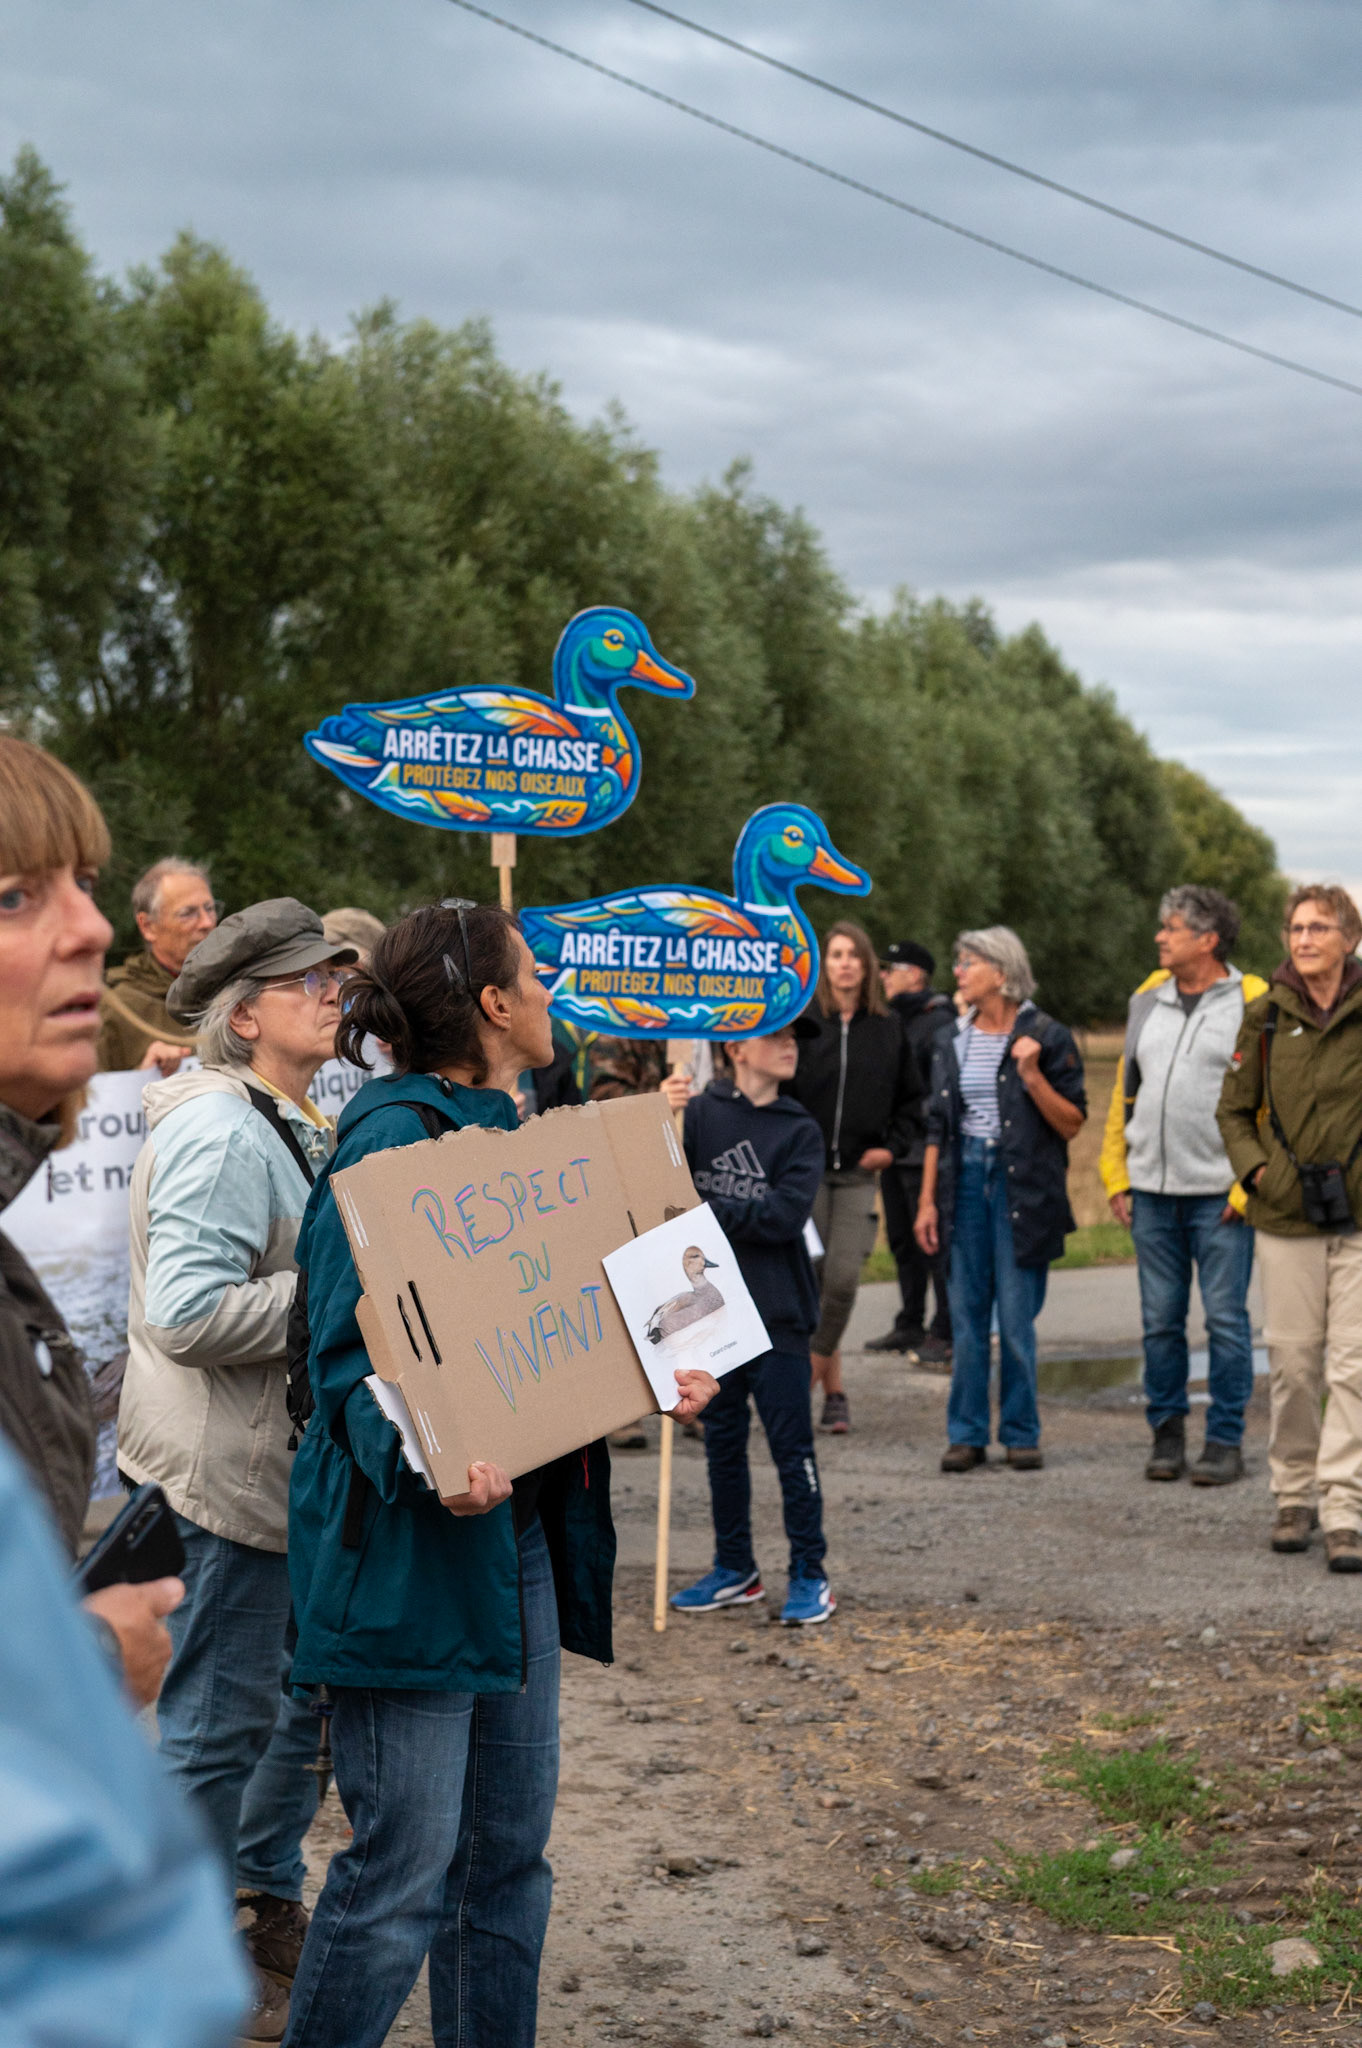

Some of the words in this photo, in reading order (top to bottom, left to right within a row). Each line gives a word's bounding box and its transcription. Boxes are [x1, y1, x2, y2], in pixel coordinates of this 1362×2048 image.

[383, 725, 483, 764] ARRÊTEZ
[487, 735, 509, 758] LA
[512, 737, 600, 772] CHASSE
[403, 763, 482, 790] PROTÉGEZ
[485, 769, 517, 792] NOS
[520, 772, 587, 797] OISEAUX
[559, 927, 662, 968] ARRÊTEZ
[665, 937, 688, 961] LA
[691, 938, 780, 973] CHASSE
[579, 968, 660, 995] PROTÉGEZ
[663, 973, 696, 997] NOS
[699, 974, 765, 999] OISEAUX
[693, 1170, 771, 1200] adida
[411, 1156, 591, 1263] RESPECT
[508, 1241, 551, 1293] DU
